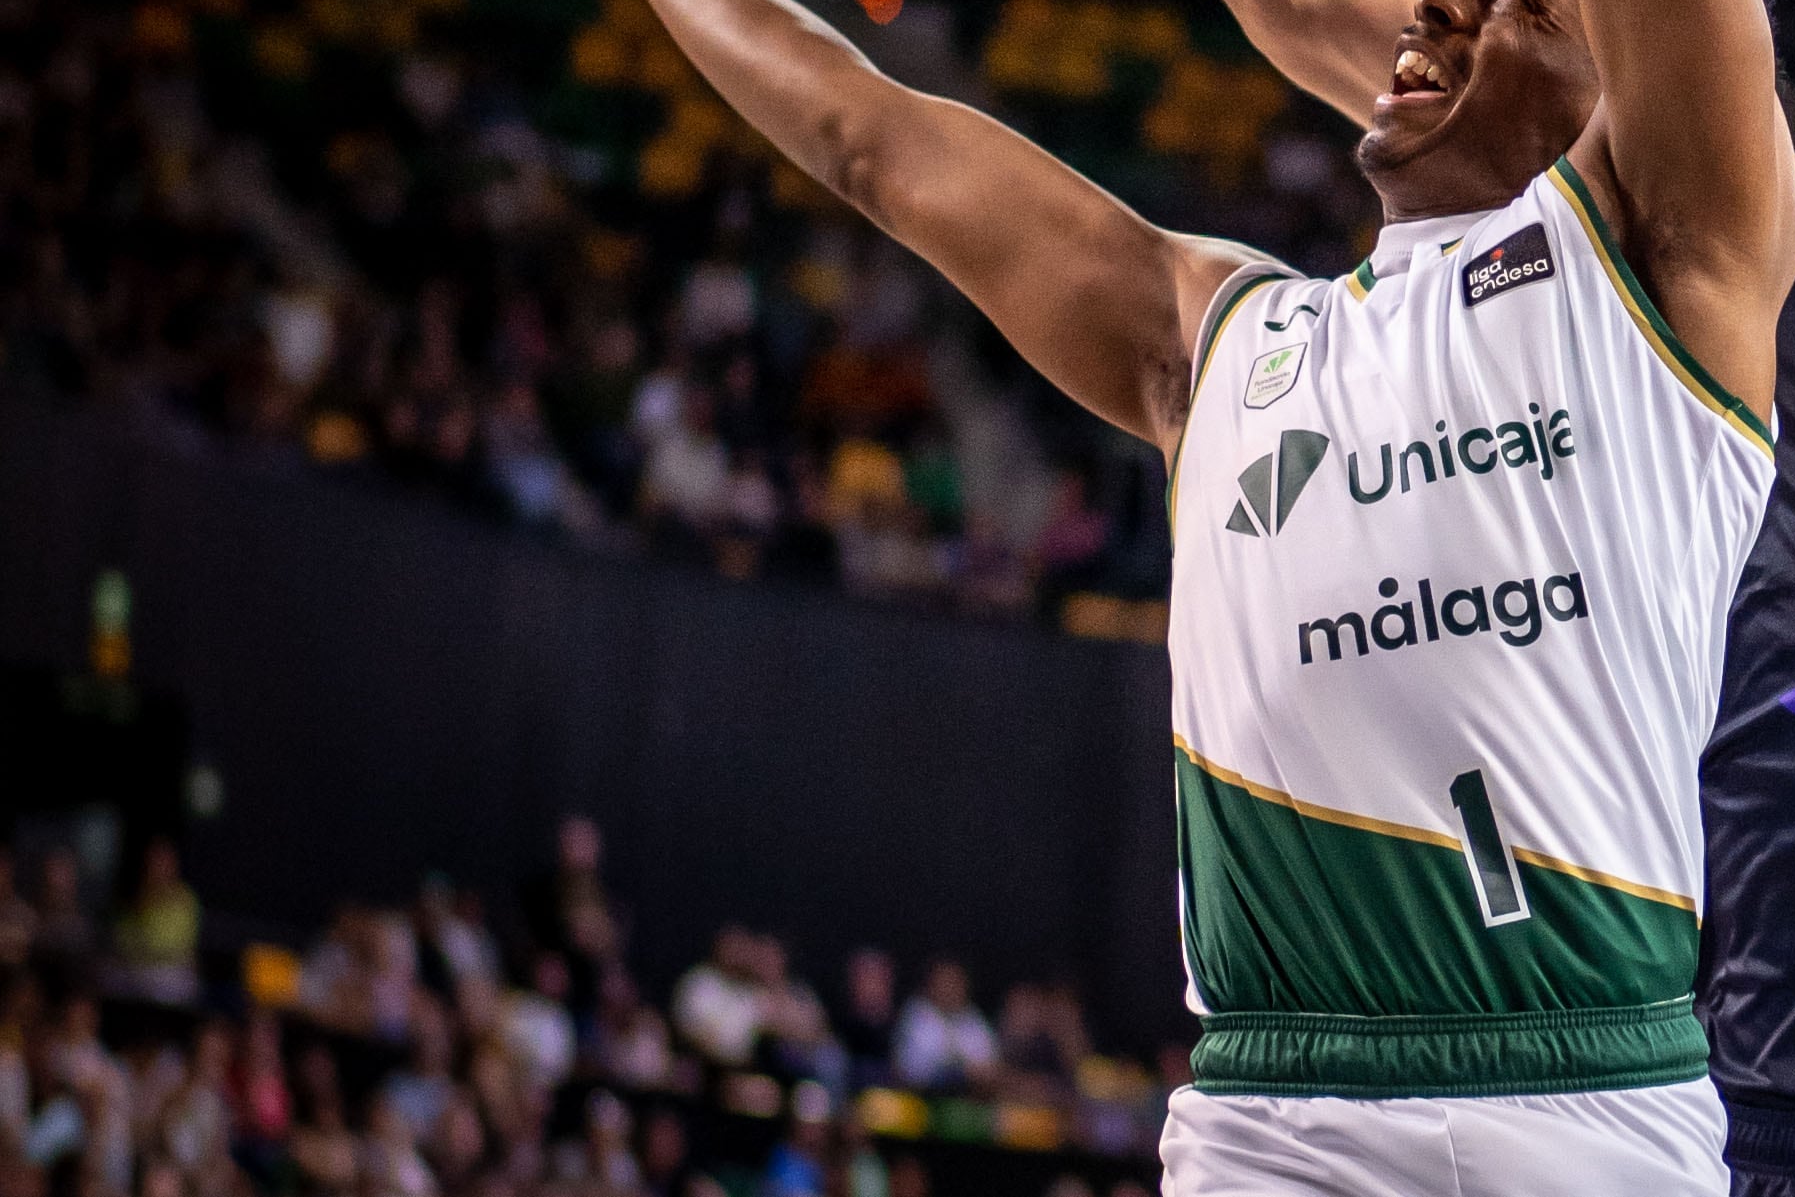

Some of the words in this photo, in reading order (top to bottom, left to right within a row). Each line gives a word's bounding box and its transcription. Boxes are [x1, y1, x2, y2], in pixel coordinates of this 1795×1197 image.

[1469, 260, 1502, 286] liga
[1471, 258, 1549, 298] endesa
[1347, 401, 1577, 505] Unicaja
[1449, 768, 1532, 929] 1
